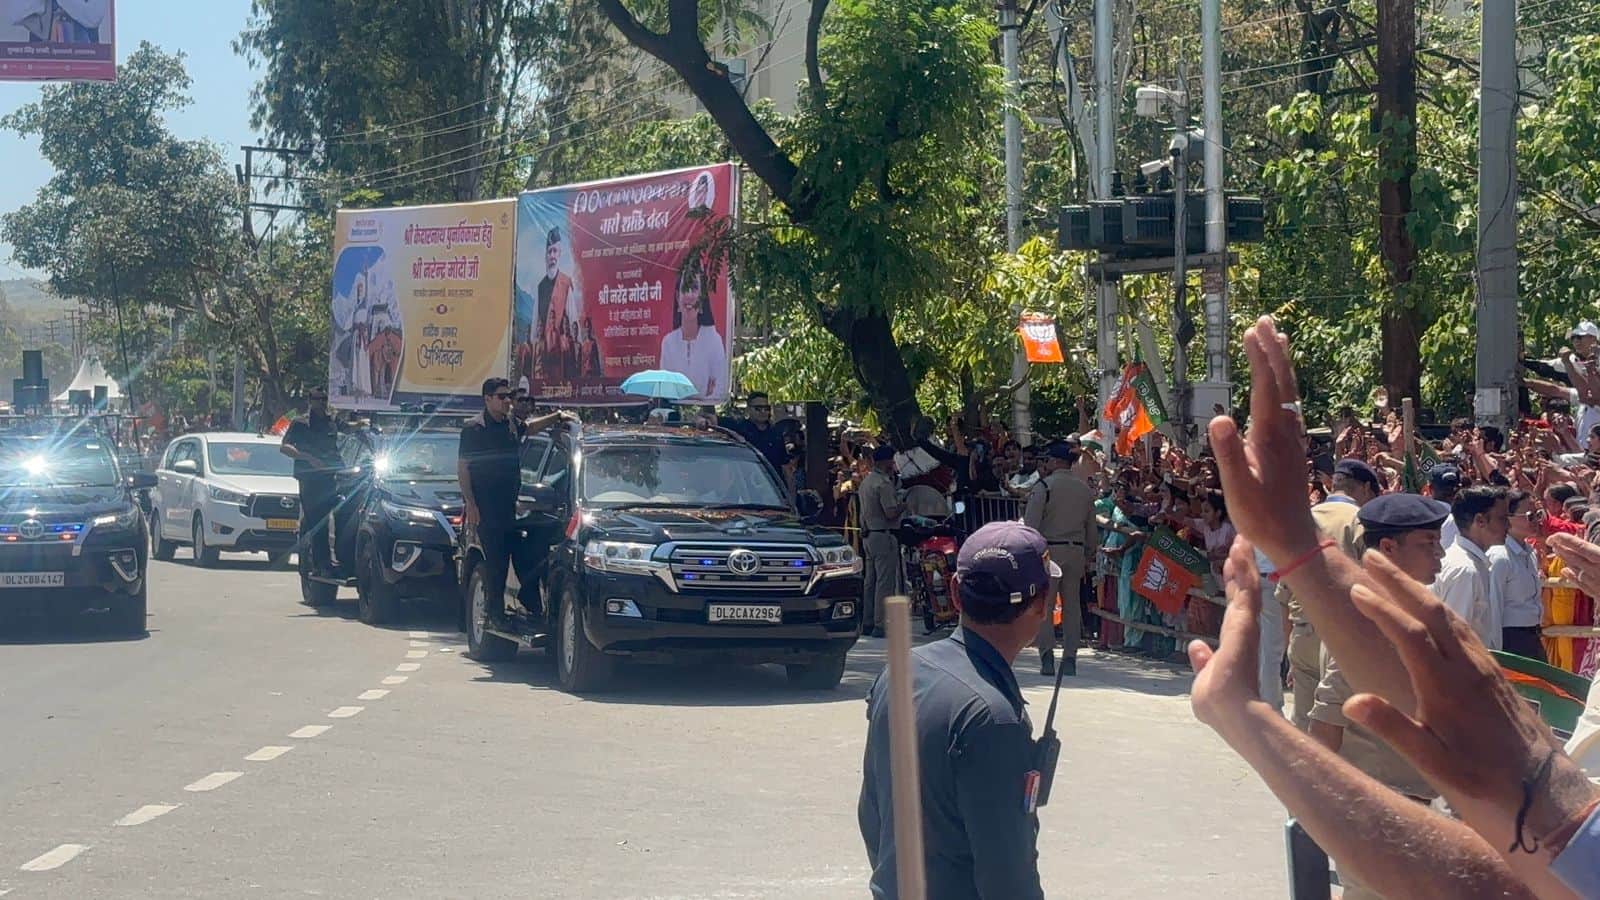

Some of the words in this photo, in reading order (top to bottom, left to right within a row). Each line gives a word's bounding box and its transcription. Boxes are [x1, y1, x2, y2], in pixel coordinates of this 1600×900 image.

[404, 223, 414, 245] श्री
[414, 223, 446, 244] केदारनाथ
[482, 220, 493, 249] हेतु
[600, 212, 620, 236] नारी
[622, 208, 646, 232] शक्ति
[412, 256, 422, 279] श्री
[424, 256, 446, 279] नरेन्द्र
[448, 256, 466, 278] मोदी
[468, 256, 479, 278] जी
[598, 284, 609, 305] श्री
[610, 283, 628, 304] नरेंद्र
[628, 281, 648, 302] मोदी
[649, 280, 662, 301] जी
